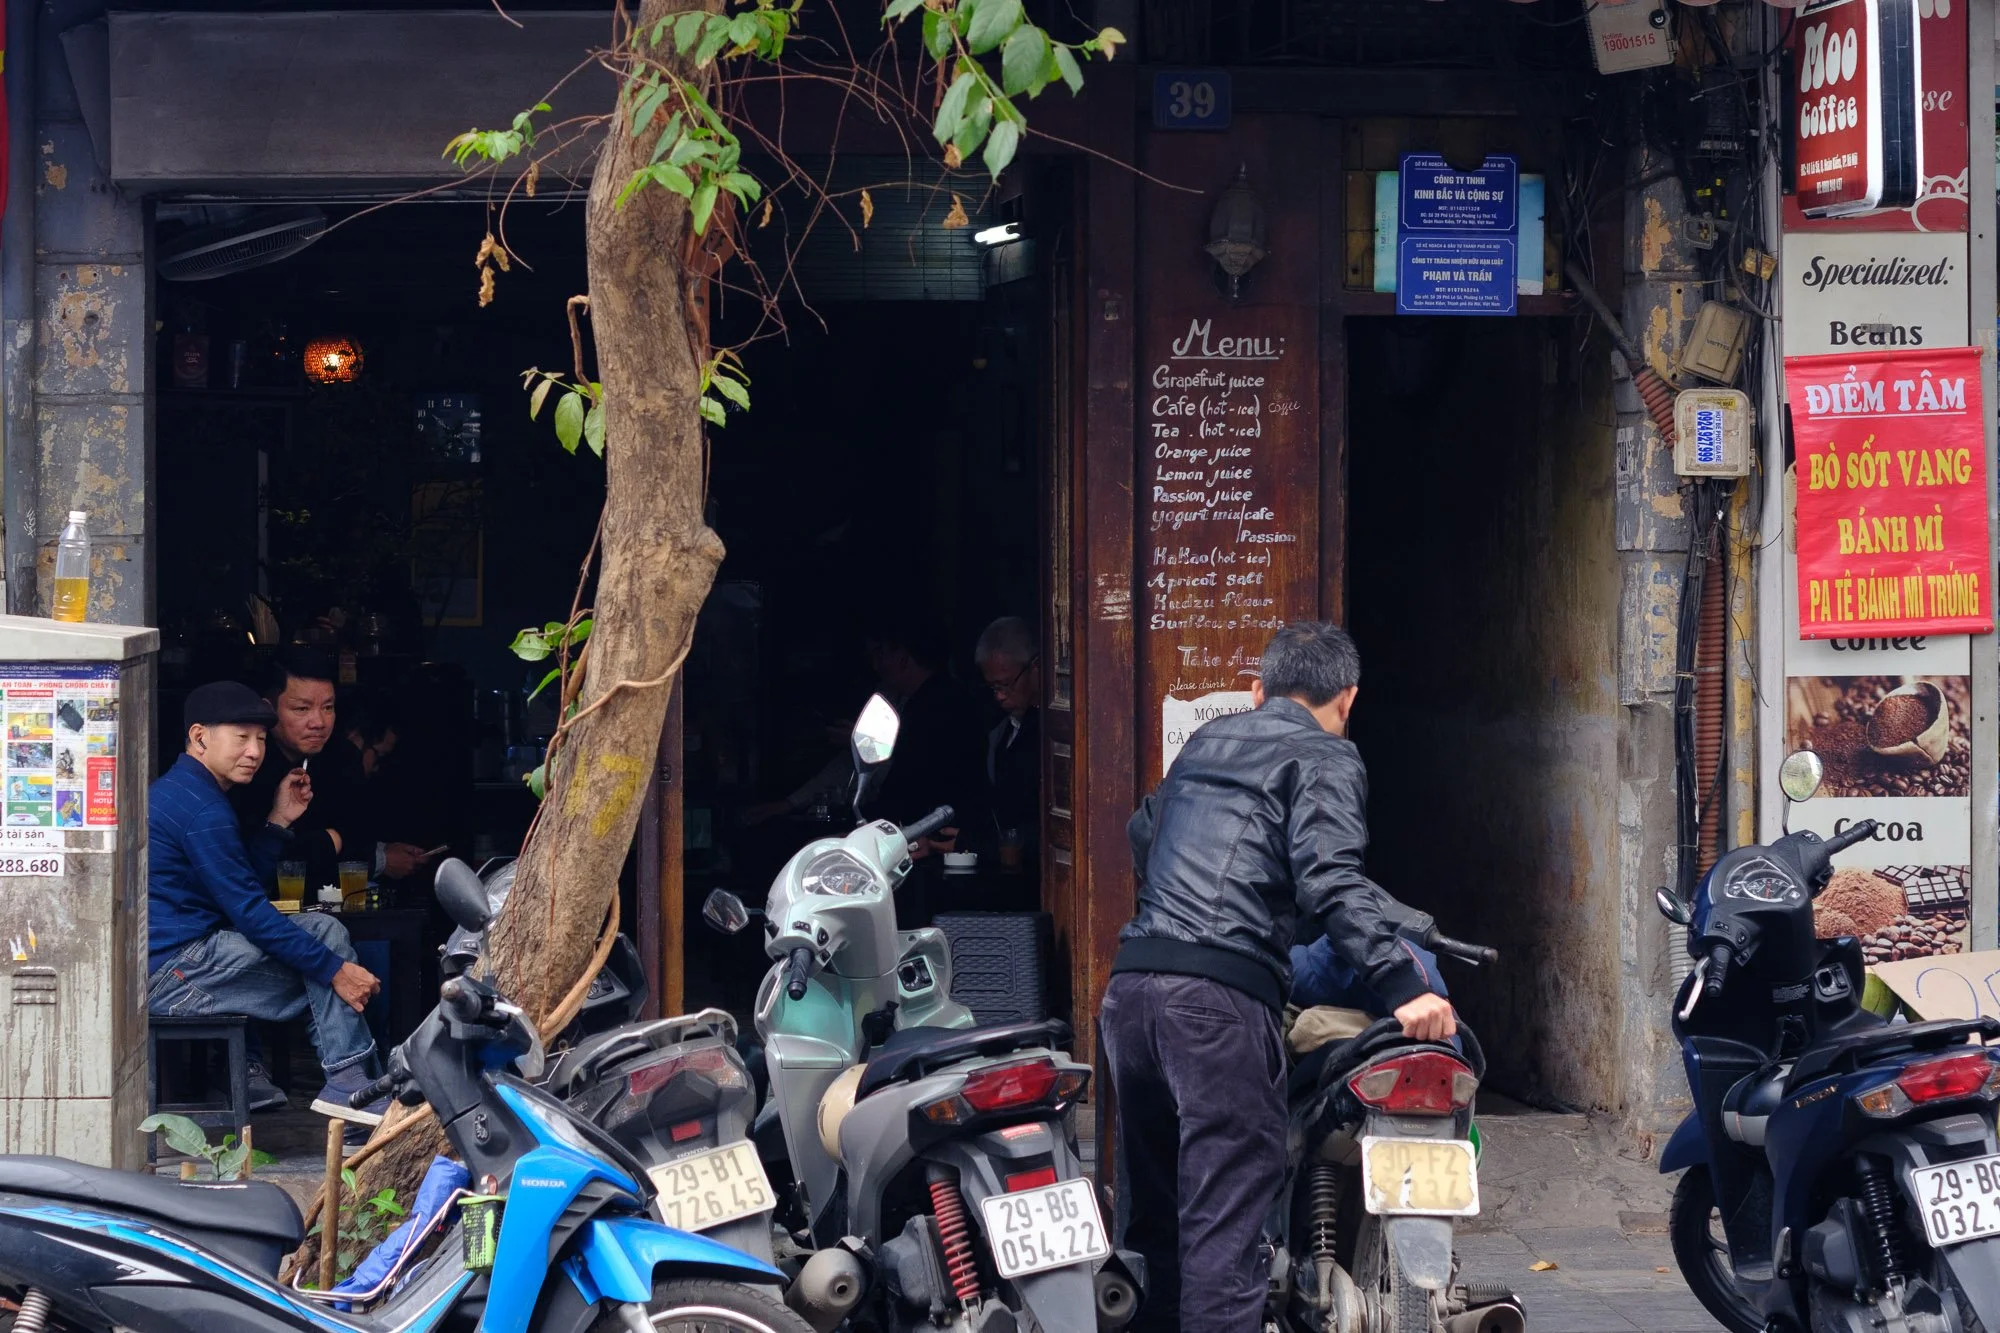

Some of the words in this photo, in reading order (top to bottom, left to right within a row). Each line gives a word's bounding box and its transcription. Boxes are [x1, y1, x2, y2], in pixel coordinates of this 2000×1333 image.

[1604, 32, 1656, 52] 19001515
[1169, 81, 1216, 118] 39
[1800, 94, 1858, 139] Coffee
[1434, 174, 1454, 184] CÔNG
[1456, 176, 1464, 184] TY
[1466, 176, 1486, 185] TNHH
[1414, 189, 1434, 200] KINH
[1436, 187, 1453, 200] BẮC
[1454, 188, 1466, 200] VÀ
[1468, 188, 1490, 202] CỘNG
[1492, 190, 1504, 203] SỰ
[1423, 271, 1450, 283] PHẠM
[1453, 269, 1465, 281] VÀ
[1802, 255, 1954, 292] Specialized:
[1172, 318, 1285, 357] Menu:
[1830, 321, 1923, 346] Beans
[1152, 364, 1226, 392] Grapefruit
[1221, 375, 1264, 398] juice
[1805, 364, 1886, 414] ĐIỂM
[1893, 369, 1967, 411] TÂM
[1152, 395, 1196, 416] Cafe
[1155, 442, 1208, 464] Orange
[1208, 444, 1252, 465] juice
[1809, 442, 1840, 490] BÒ
[1846, 434, 1891, 488] SỐT
[1896, 448, 1972, 486] VANG
[1156, 464, 1204, 481] Lemon
[1206, 466, 1253, 488] juice
[1153, 486, 1205, 502] Passion
[1206, 486, 1253, 508] juice
[1838, 506, 1909, 554] BÁNH
[1914, 504, 1944, 552] MÌ
[1147, 572, 1218, 594] Apricot
[1810, 579, 1832, 622] PA
[1835, 568, 1853, 621] TÊ
[1858, 568, 1900, 620] BÁNH
[1903, 566, 1924, 618] MÌ
[1927, 560, 1979, 617] TRỨNG
[1169, 678, 1197, 696] please
[1194, 704, 1224, 720] MÓN
[1168, 728, 1184, 744] CÀ
[1834, 818, 1924, 842] Ccoa
[677, 1146, 710, 1159] HONDA
[520, 1178, 567, 1188] HONDA
[664, 1150, 744, 1196] 29-B1
[668, 1178, 766, 1230] 726.45
[999, 1187, 1079, 1234] 29-BG
[1001, 1222, 1100, 1272] 054.22
